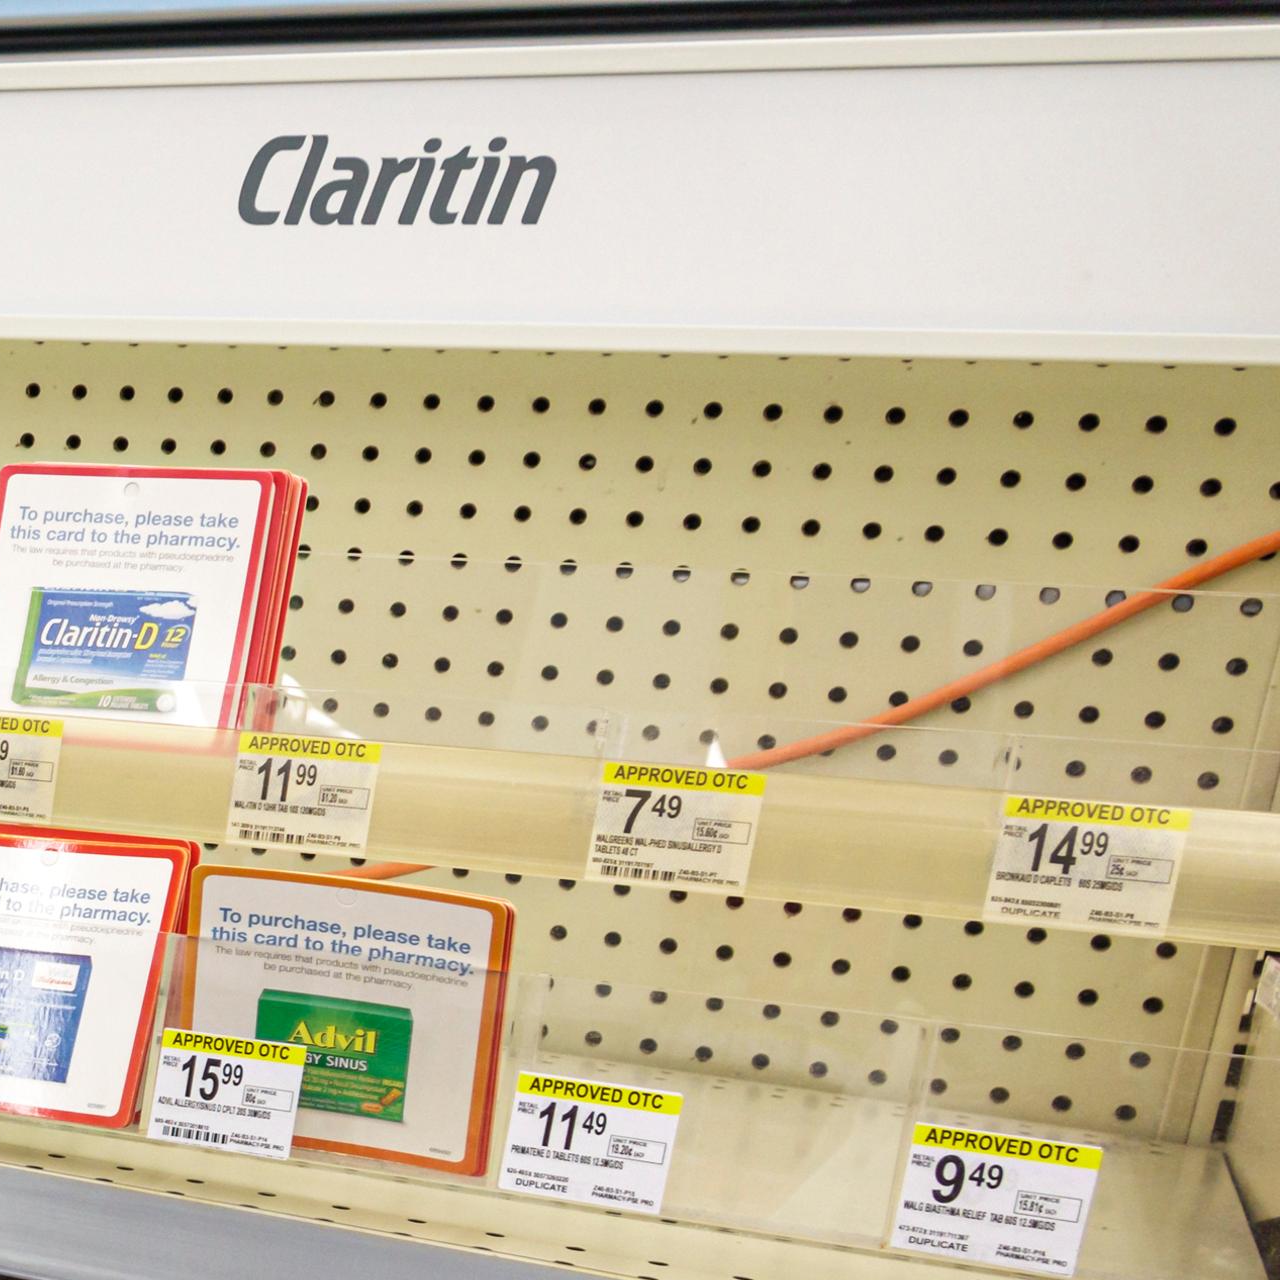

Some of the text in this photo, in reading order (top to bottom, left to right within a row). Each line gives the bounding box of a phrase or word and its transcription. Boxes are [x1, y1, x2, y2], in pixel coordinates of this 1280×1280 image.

[238, 135, 556, 225] Claritin
[41, 618, 158, 650] Claritin-D
[33, 674, 60, 683] Allergy
[70, 676, 113, 685] Congestion
[248, 736, 366, 758] APPROVED OTC
[1018, 799, 1170, 824] APPROVED OTC
[1000, 906, 1061, 919] DUPLICATE
[219, 907, 470, 954] To purchase, please take
[212, 926, 474, 976] this card to the pharmacy.
[215, 946, 468, 987] The law requires that products with pseudoephedrine
[263, 962, 276, 970] be
[279, 964, 330, 979] purchased
[345, 972, 361, 981] the
[172, 1033, 289, 1060] APPROVED OTC
[289, 1022, 376, 1054] Advil
[327, 1056, 368, 1072] SINUS
[925, 1129, 1078, 1162] APPROVED OTC
[908, 1235, 968, 1251] DUPLICATE
